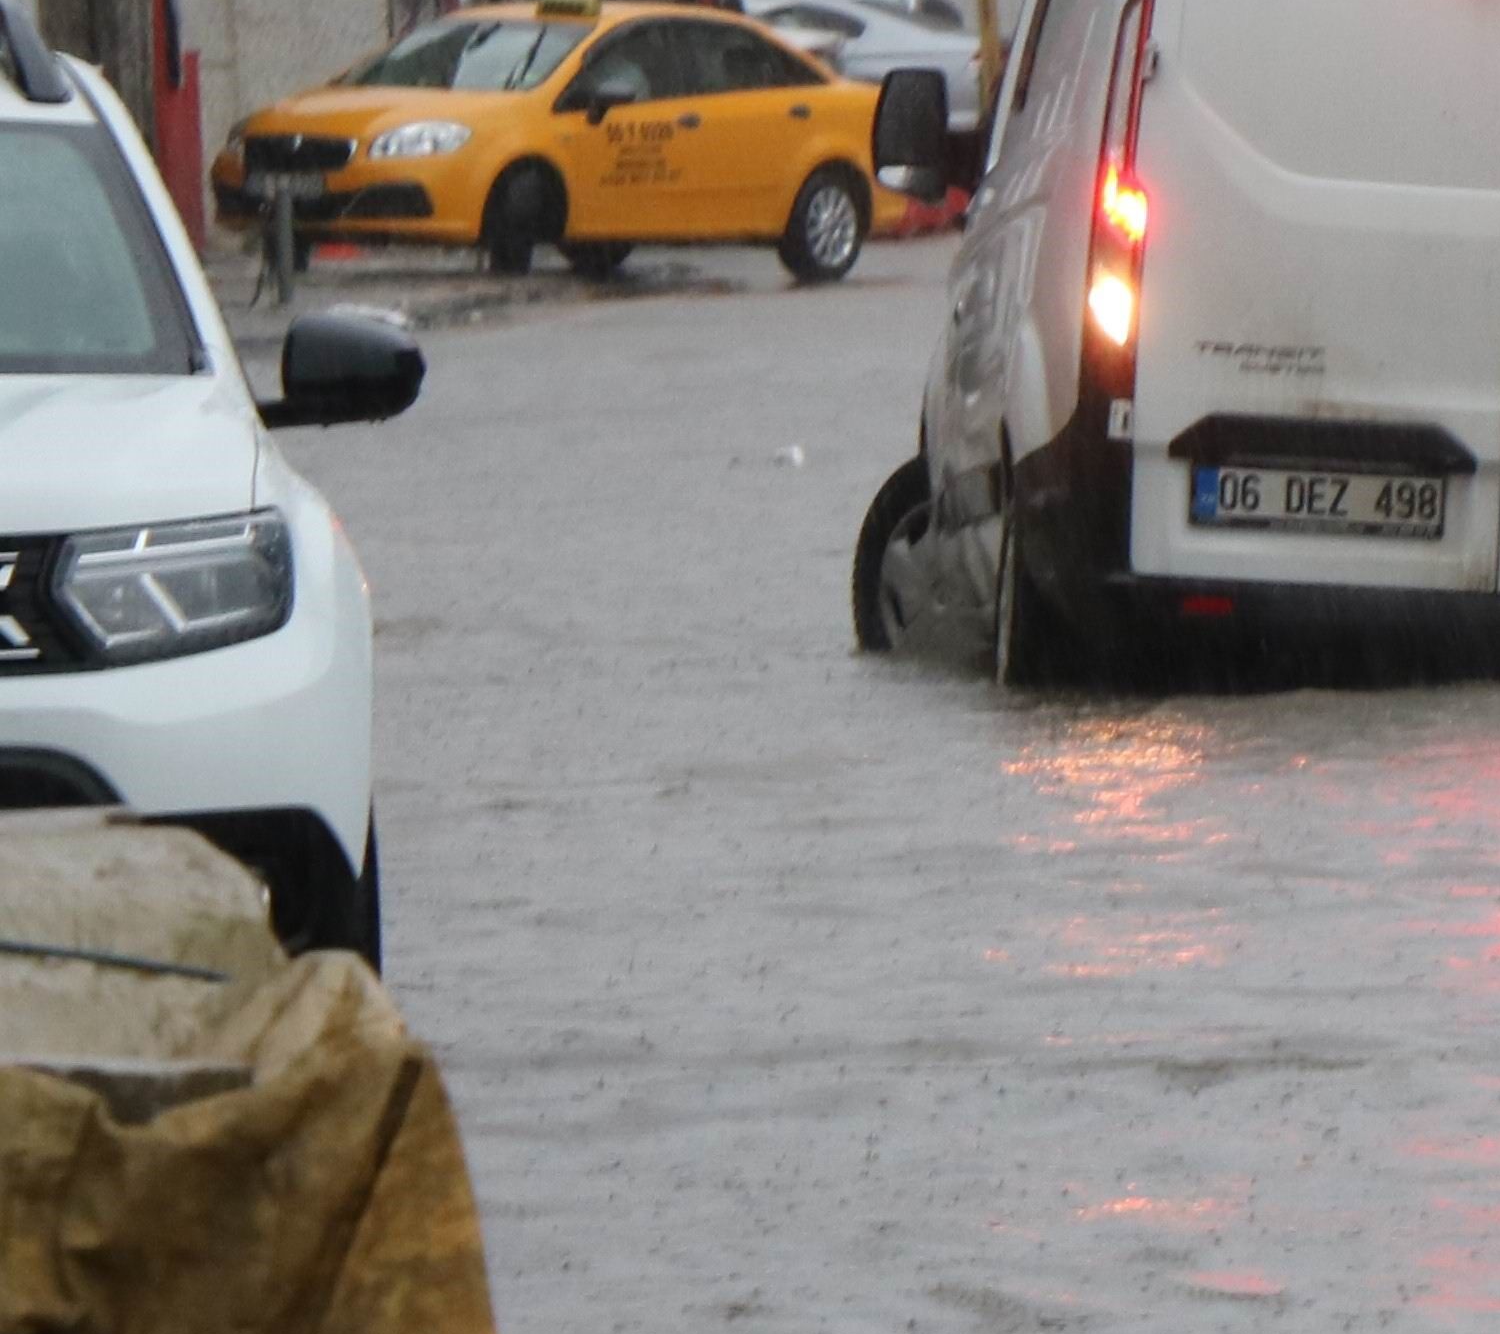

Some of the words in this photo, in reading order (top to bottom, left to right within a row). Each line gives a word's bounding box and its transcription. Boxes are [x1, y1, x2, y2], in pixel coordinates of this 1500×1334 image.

[1218, 471, 1261, 512] 06
[1284, 474, 1351, 517] DEZ
[1373, 478, 1439, 522] 498
